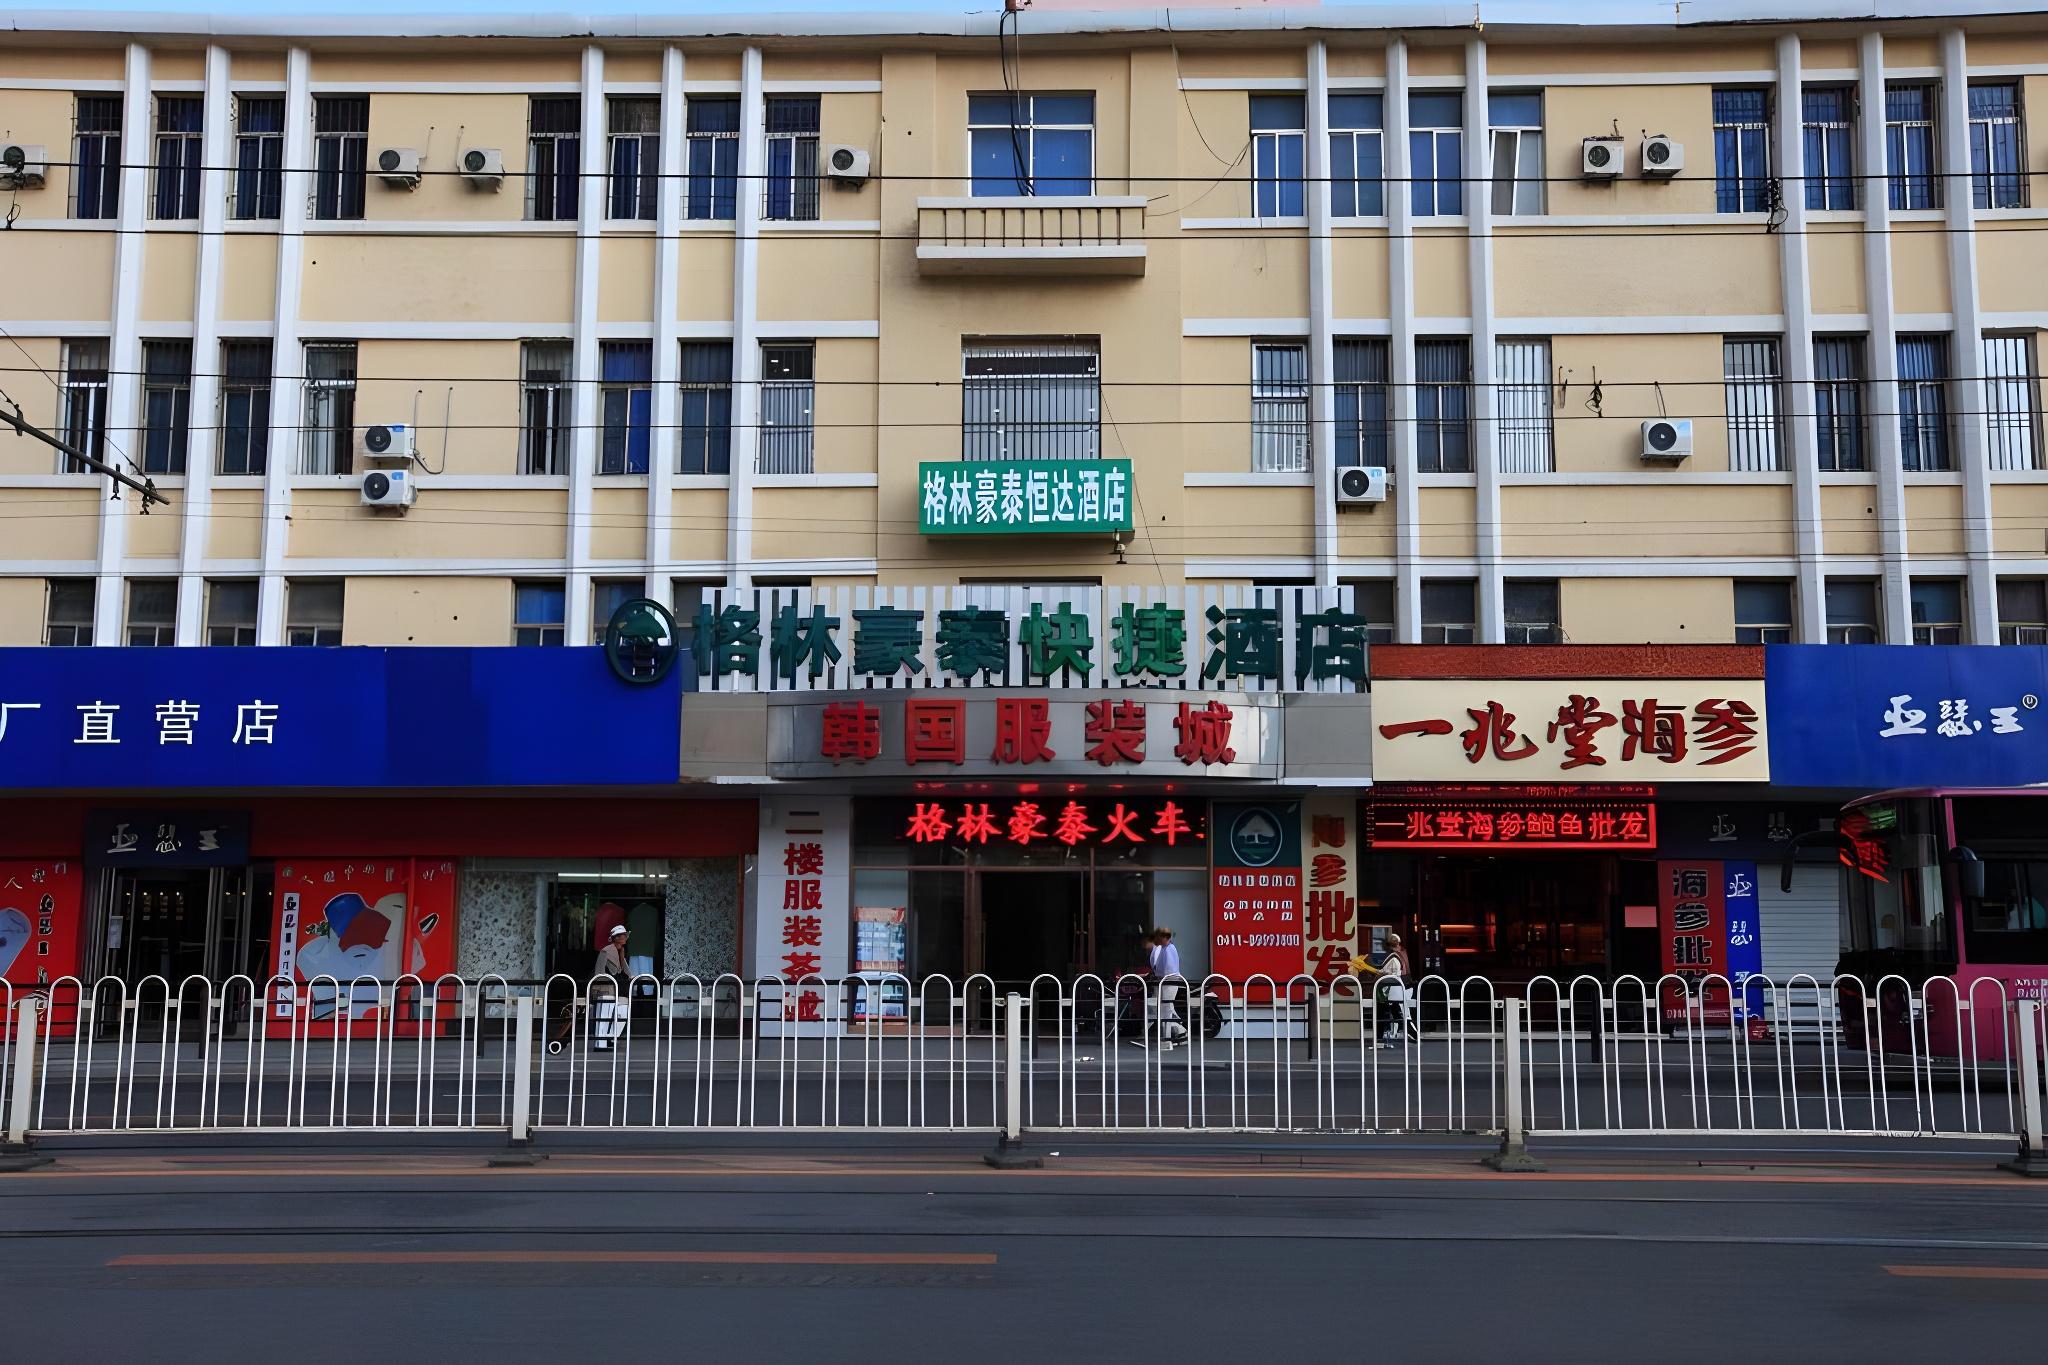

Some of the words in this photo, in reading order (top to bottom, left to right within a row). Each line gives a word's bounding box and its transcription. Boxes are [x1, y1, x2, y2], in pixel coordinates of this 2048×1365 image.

[923, 467, 1126, 526] 格林豪泰恒达酒店
[692, 601, 1368, 681] 格林豪泰快捷酒店
[820, 697, 1237, 767] 韩国服装城
[1378, 694, 1760, 771] 一兆堂海参
